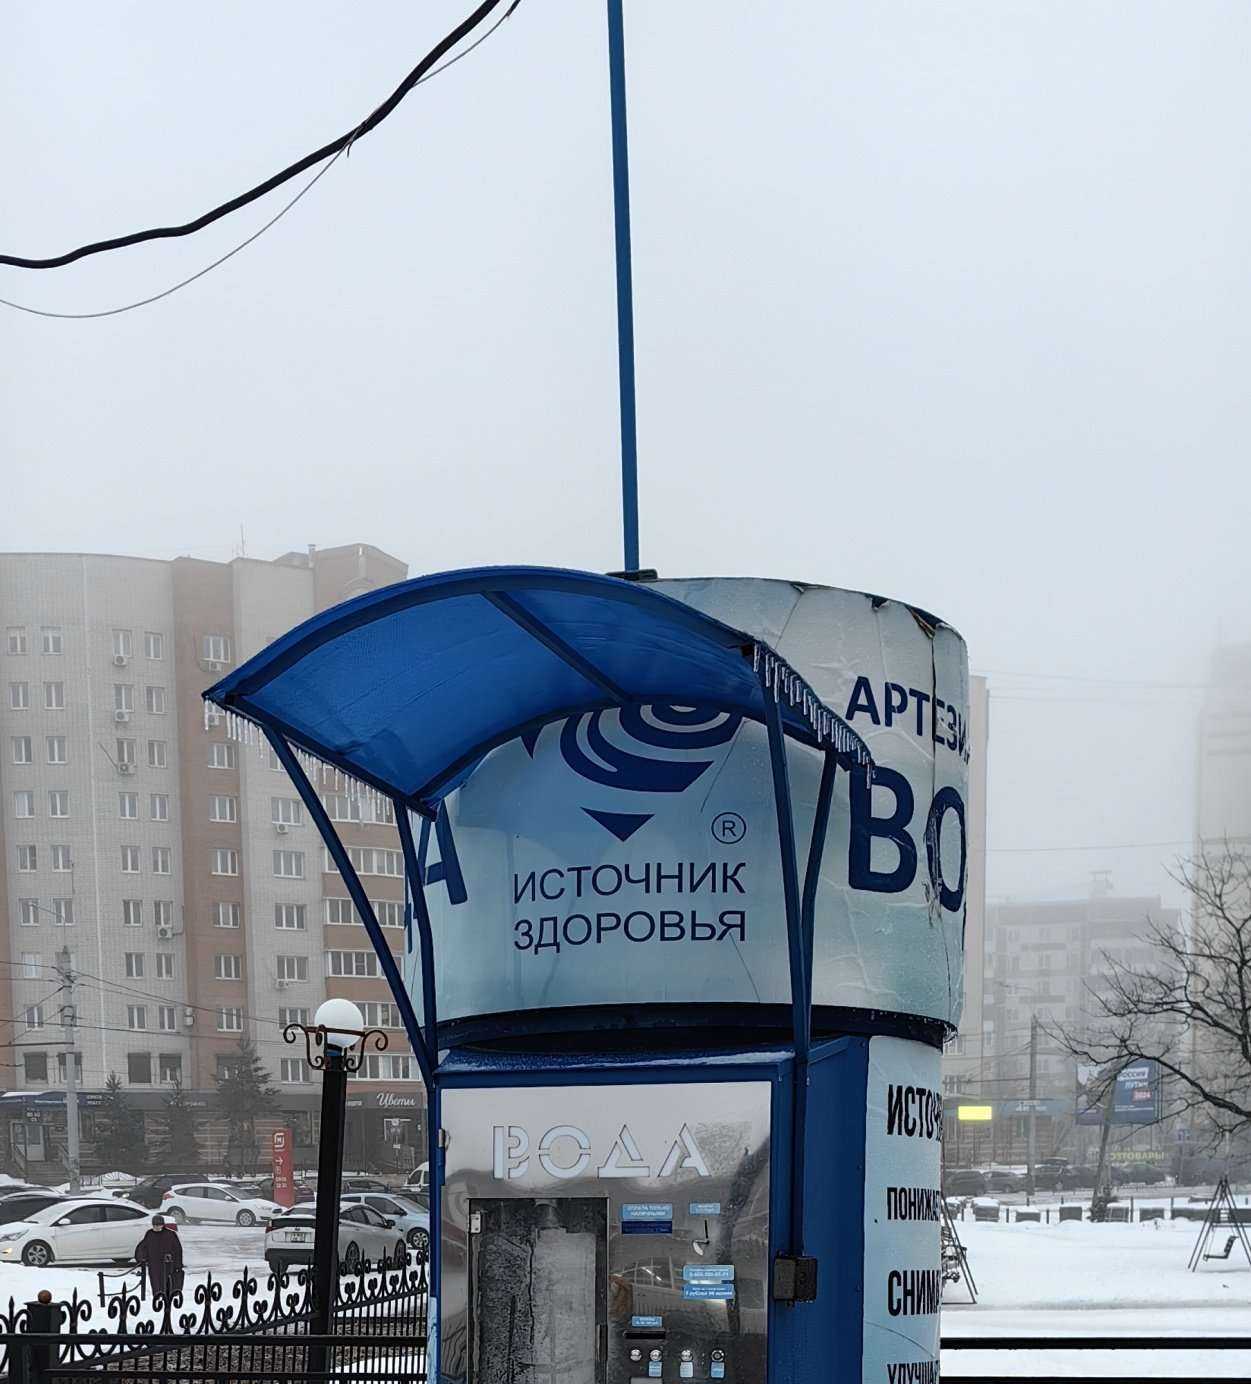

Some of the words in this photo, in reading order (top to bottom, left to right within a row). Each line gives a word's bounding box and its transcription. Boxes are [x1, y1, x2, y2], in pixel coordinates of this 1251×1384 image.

[845, 675, 970, 766] АРТЕЗИ
[513, 862, 747, 904] ИСТОЧНИК
[513, 910, 747, 955] ЗДОРОВЬЯ
[886, 1083, 943, 1142] ИСТОЧ
[493, 1122, 712, 1180] ВОДА
